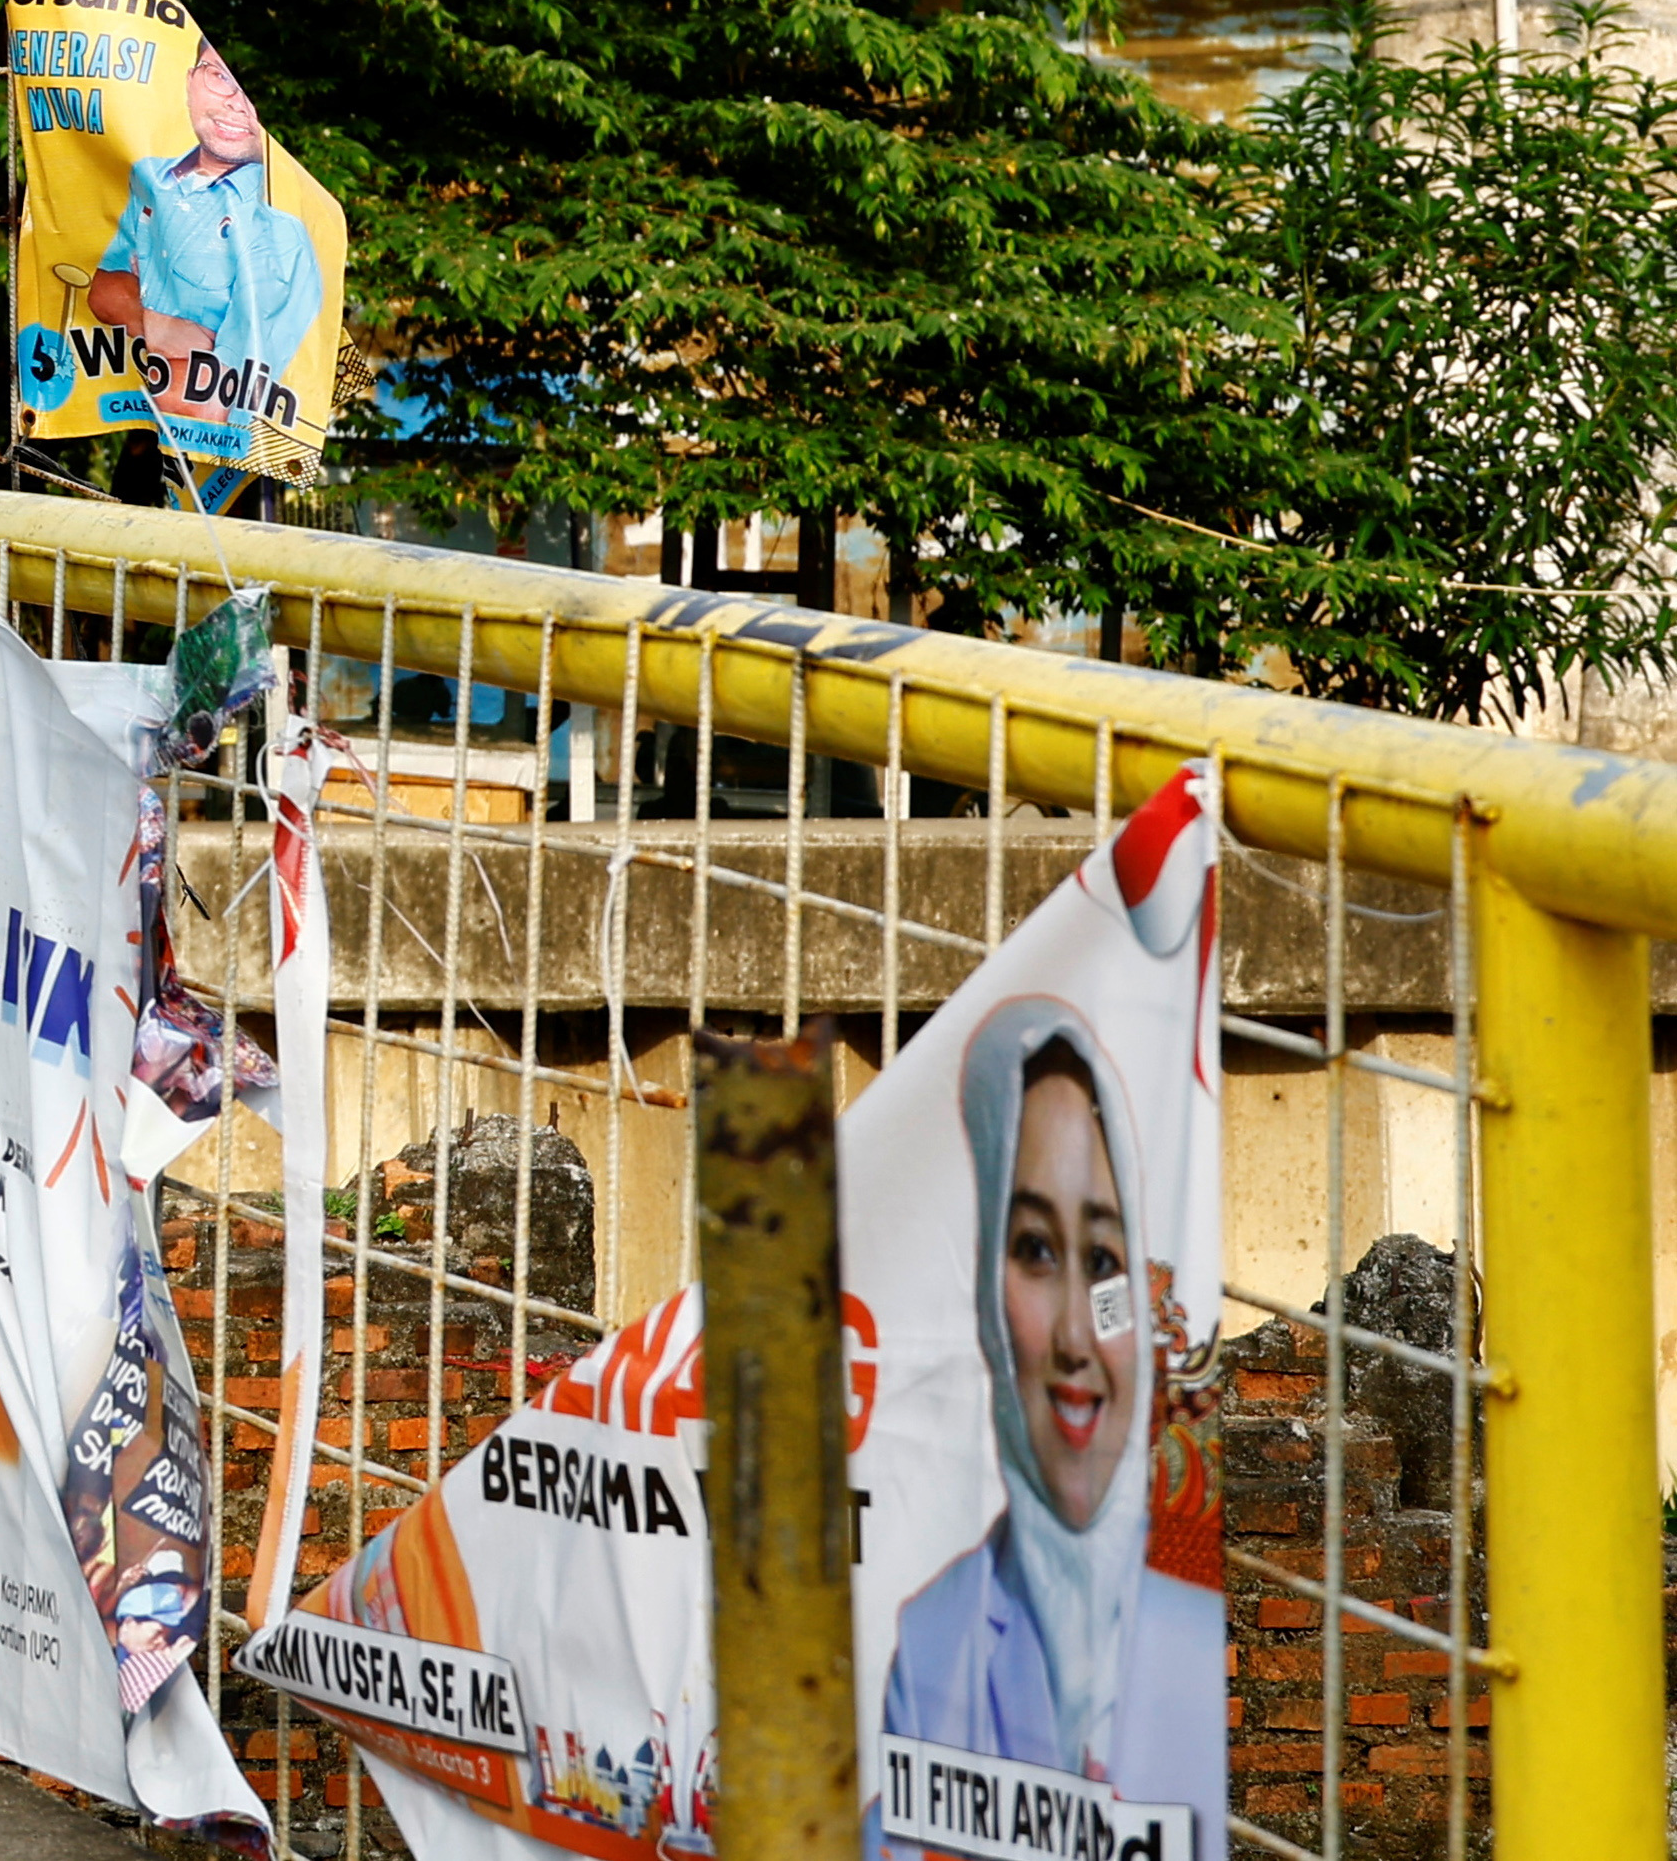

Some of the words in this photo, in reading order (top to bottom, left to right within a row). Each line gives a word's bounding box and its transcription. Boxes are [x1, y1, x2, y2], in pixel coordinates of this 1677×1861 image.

[184, 348, 297, 430] Dolin
[203, 469, 234, 511] CALEG
[482, 1434, 690, 1537] BERSAMA
[29, 1630, 60, 1671] (UPC)
[470, 1669, 516, 1736] ME
[478, 1755, 491, 1786] 3
[888, 1750, 912, 1820] 11
[929, 1761, 1000, 1841] FITRI
